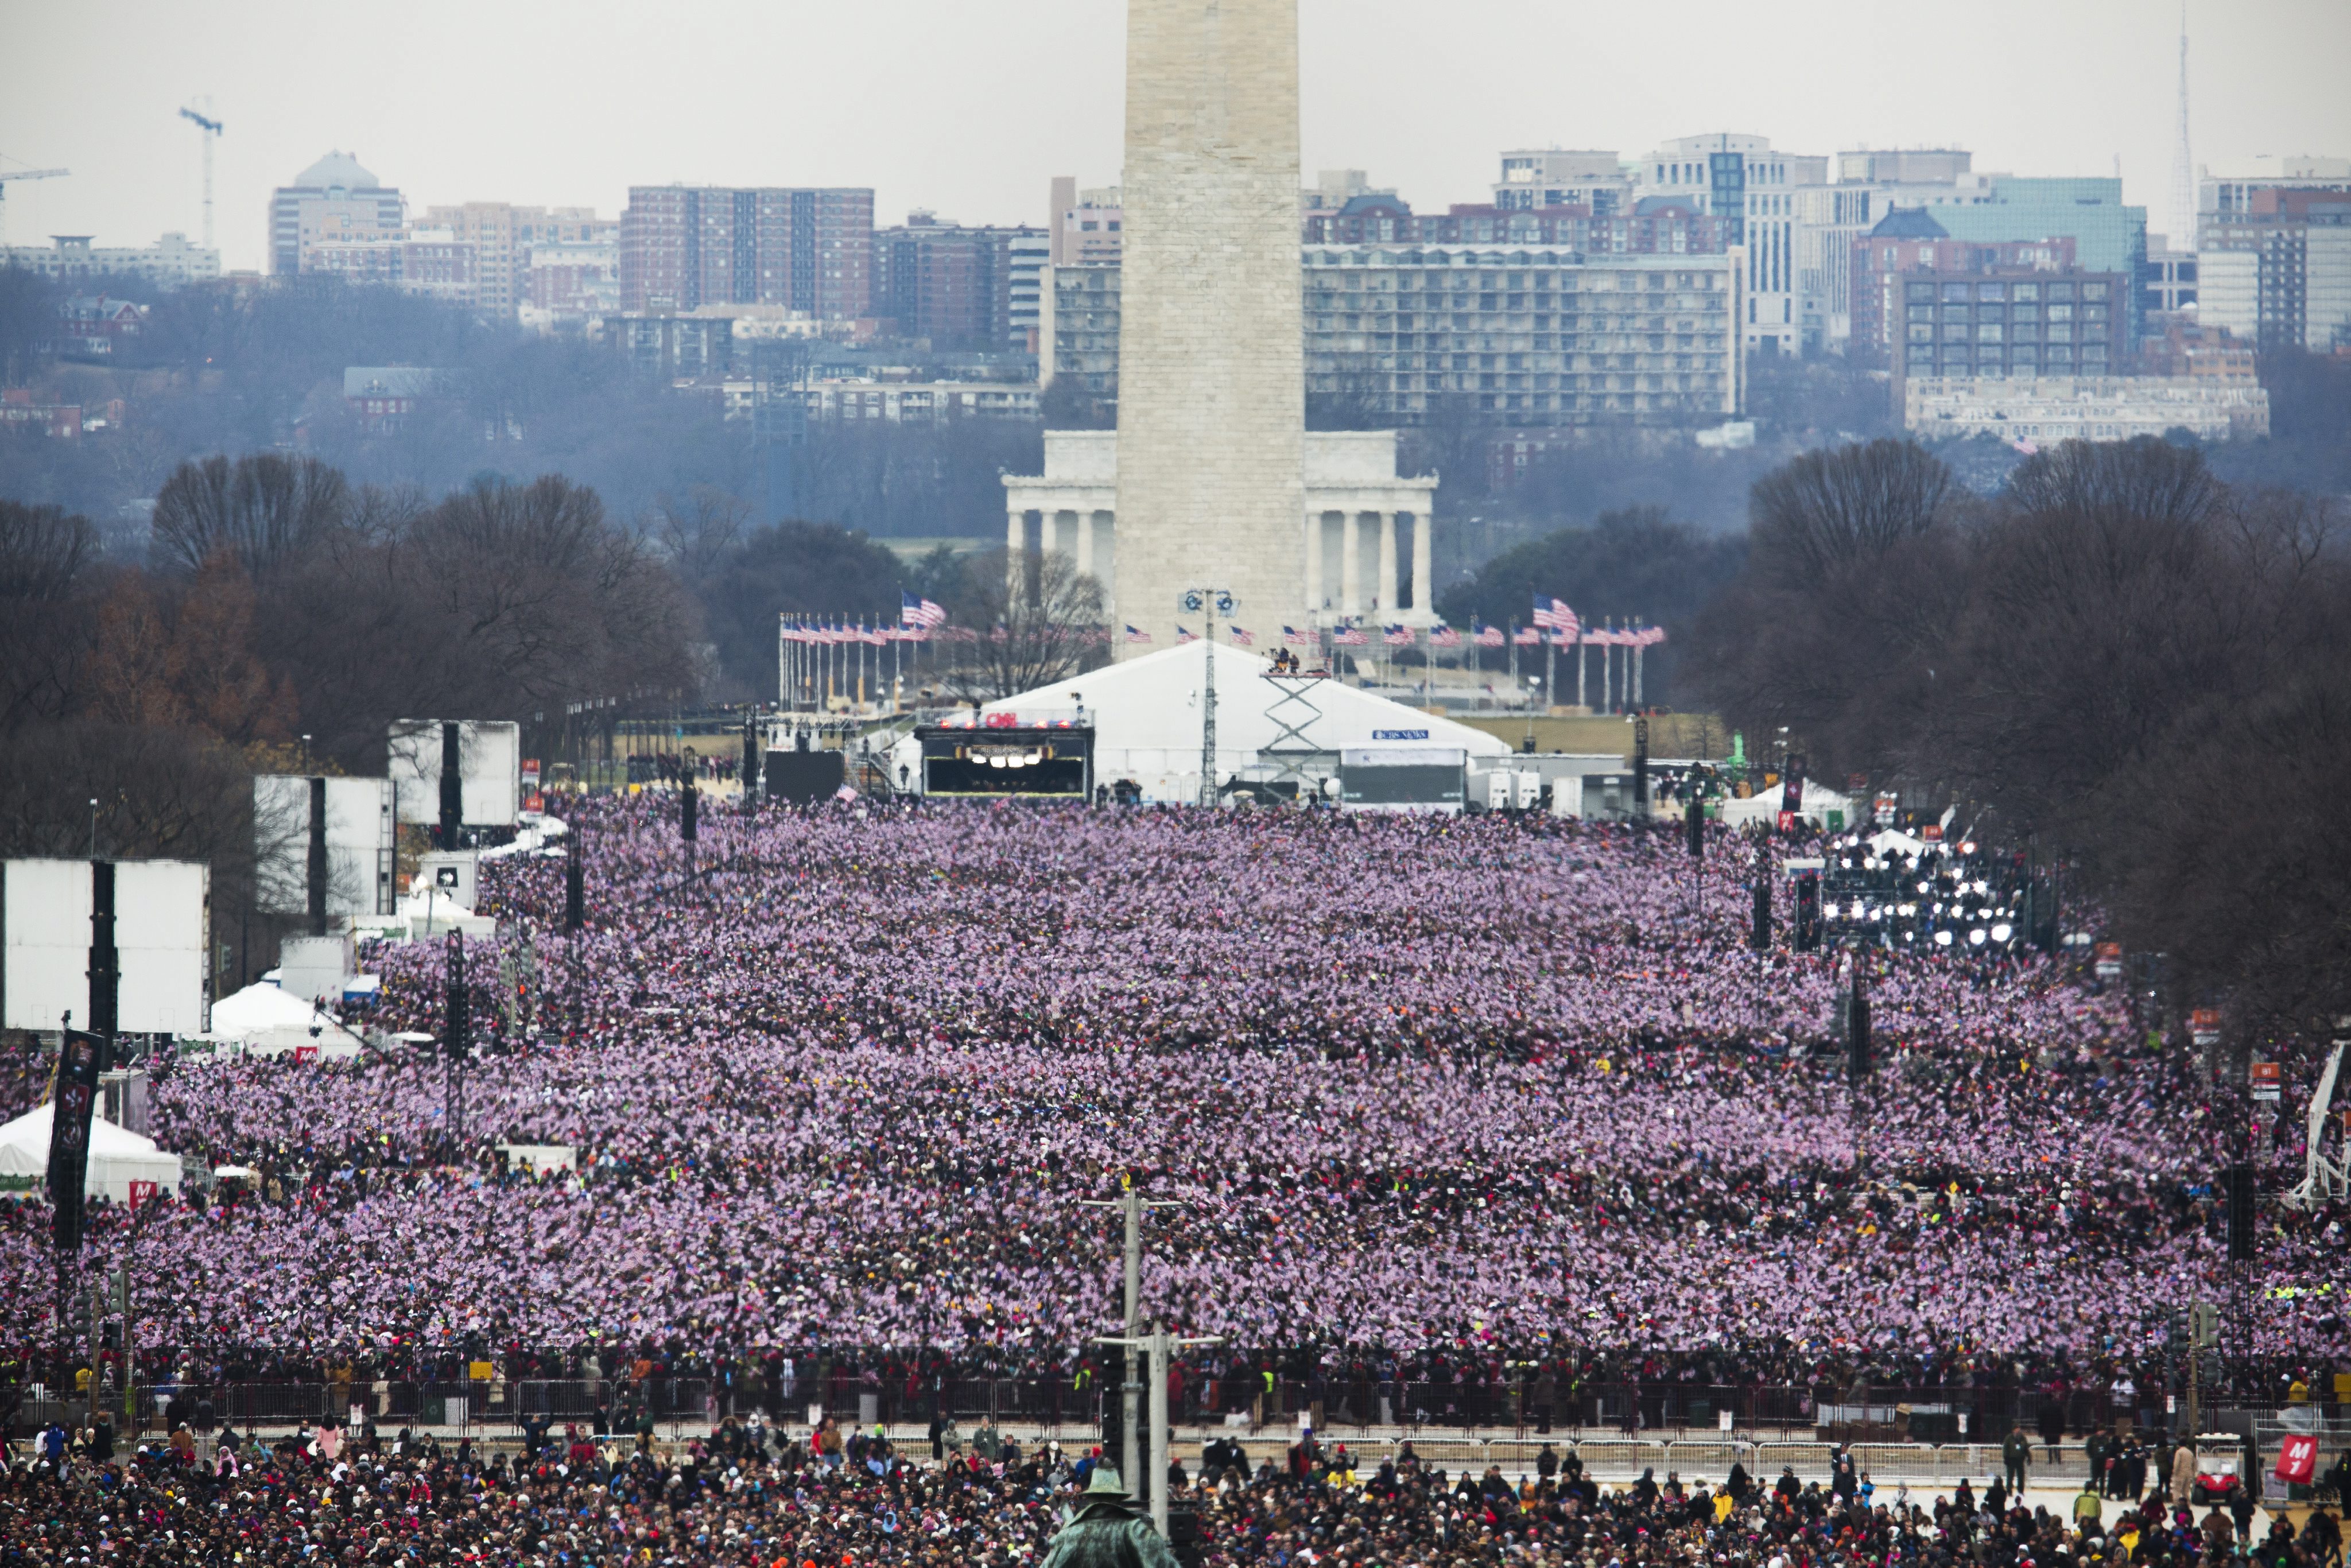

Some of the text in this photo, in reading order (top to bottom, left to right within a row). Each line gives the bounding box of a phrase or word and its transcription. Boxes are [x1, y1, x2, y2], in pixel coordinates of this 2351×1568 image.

[987, 713, 1017, 728] CNN
[1383, 731, 1399, 739] CBS
[136, 1183, 152, 1197] M
[2289, 1442, 2311, 1460] M
[2289, 1460, 2302, 1475] 1
